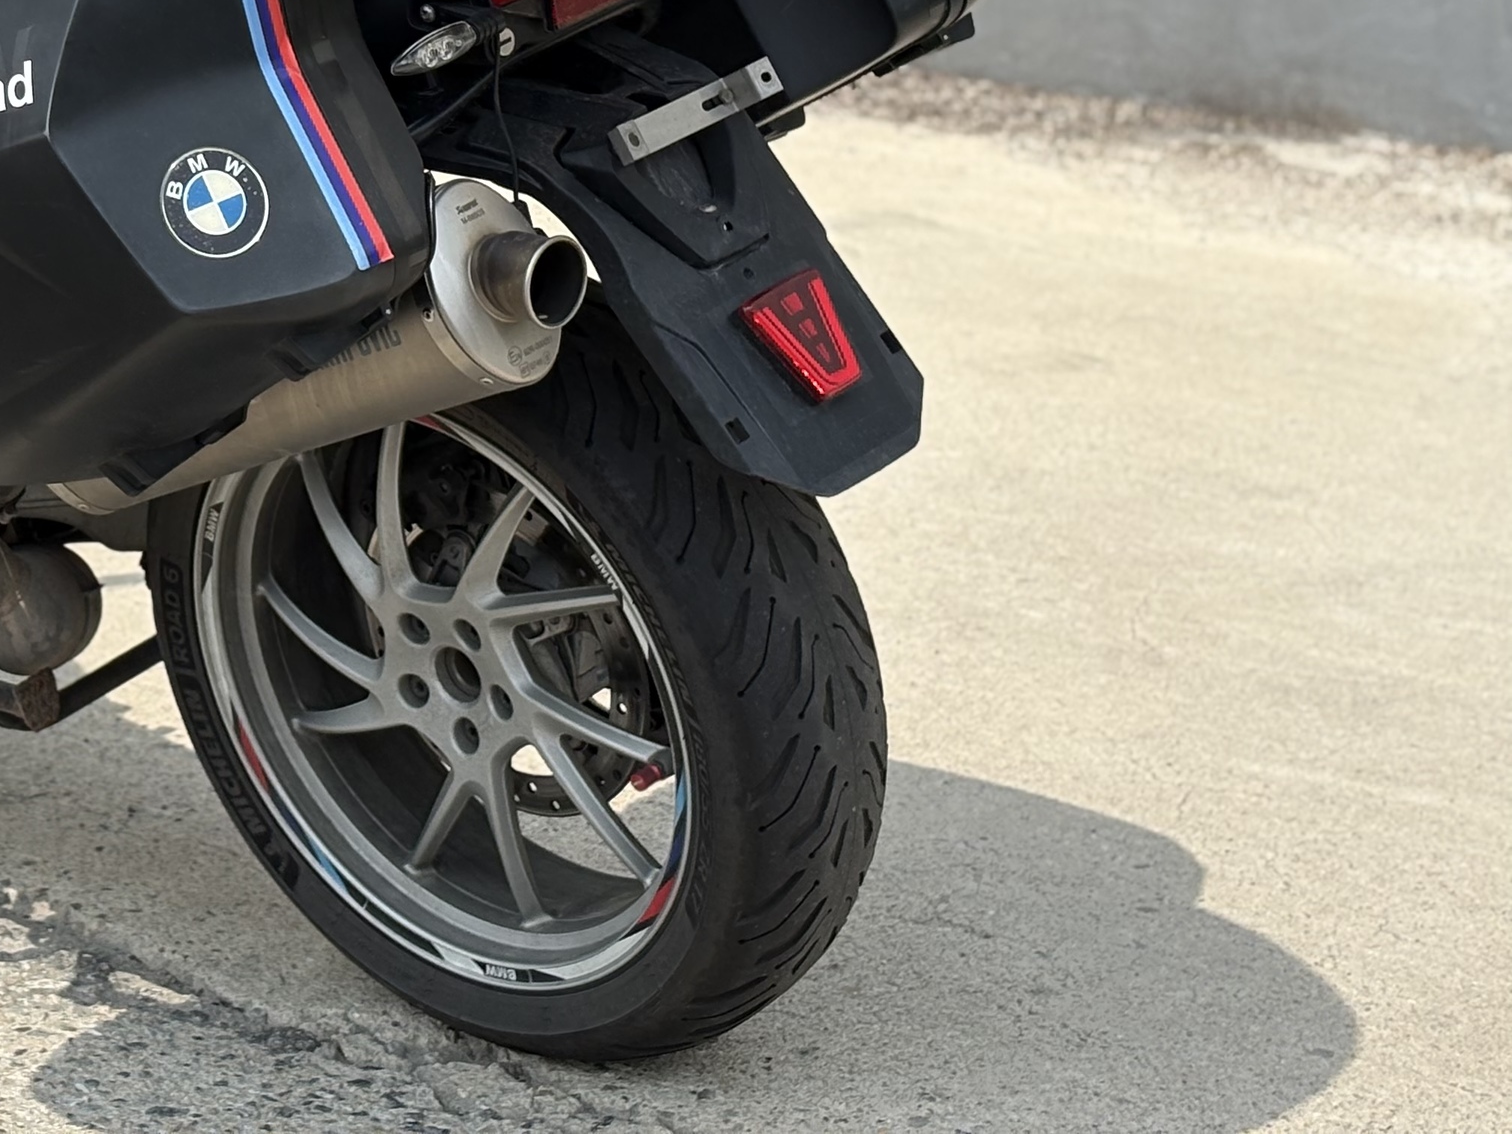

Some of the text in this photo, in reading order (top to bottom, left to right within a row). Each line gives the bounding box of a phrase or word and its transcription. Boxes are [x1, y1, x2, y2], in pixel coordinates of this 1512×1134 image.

[165, 153, 246, 201] BMW
[204, 506, 219, 542] BMW
[163, 566, 190, 663] ROAD 6
[183, 688, 265, 834] MICHELIN
[485, 964, 517, 981] BMW
